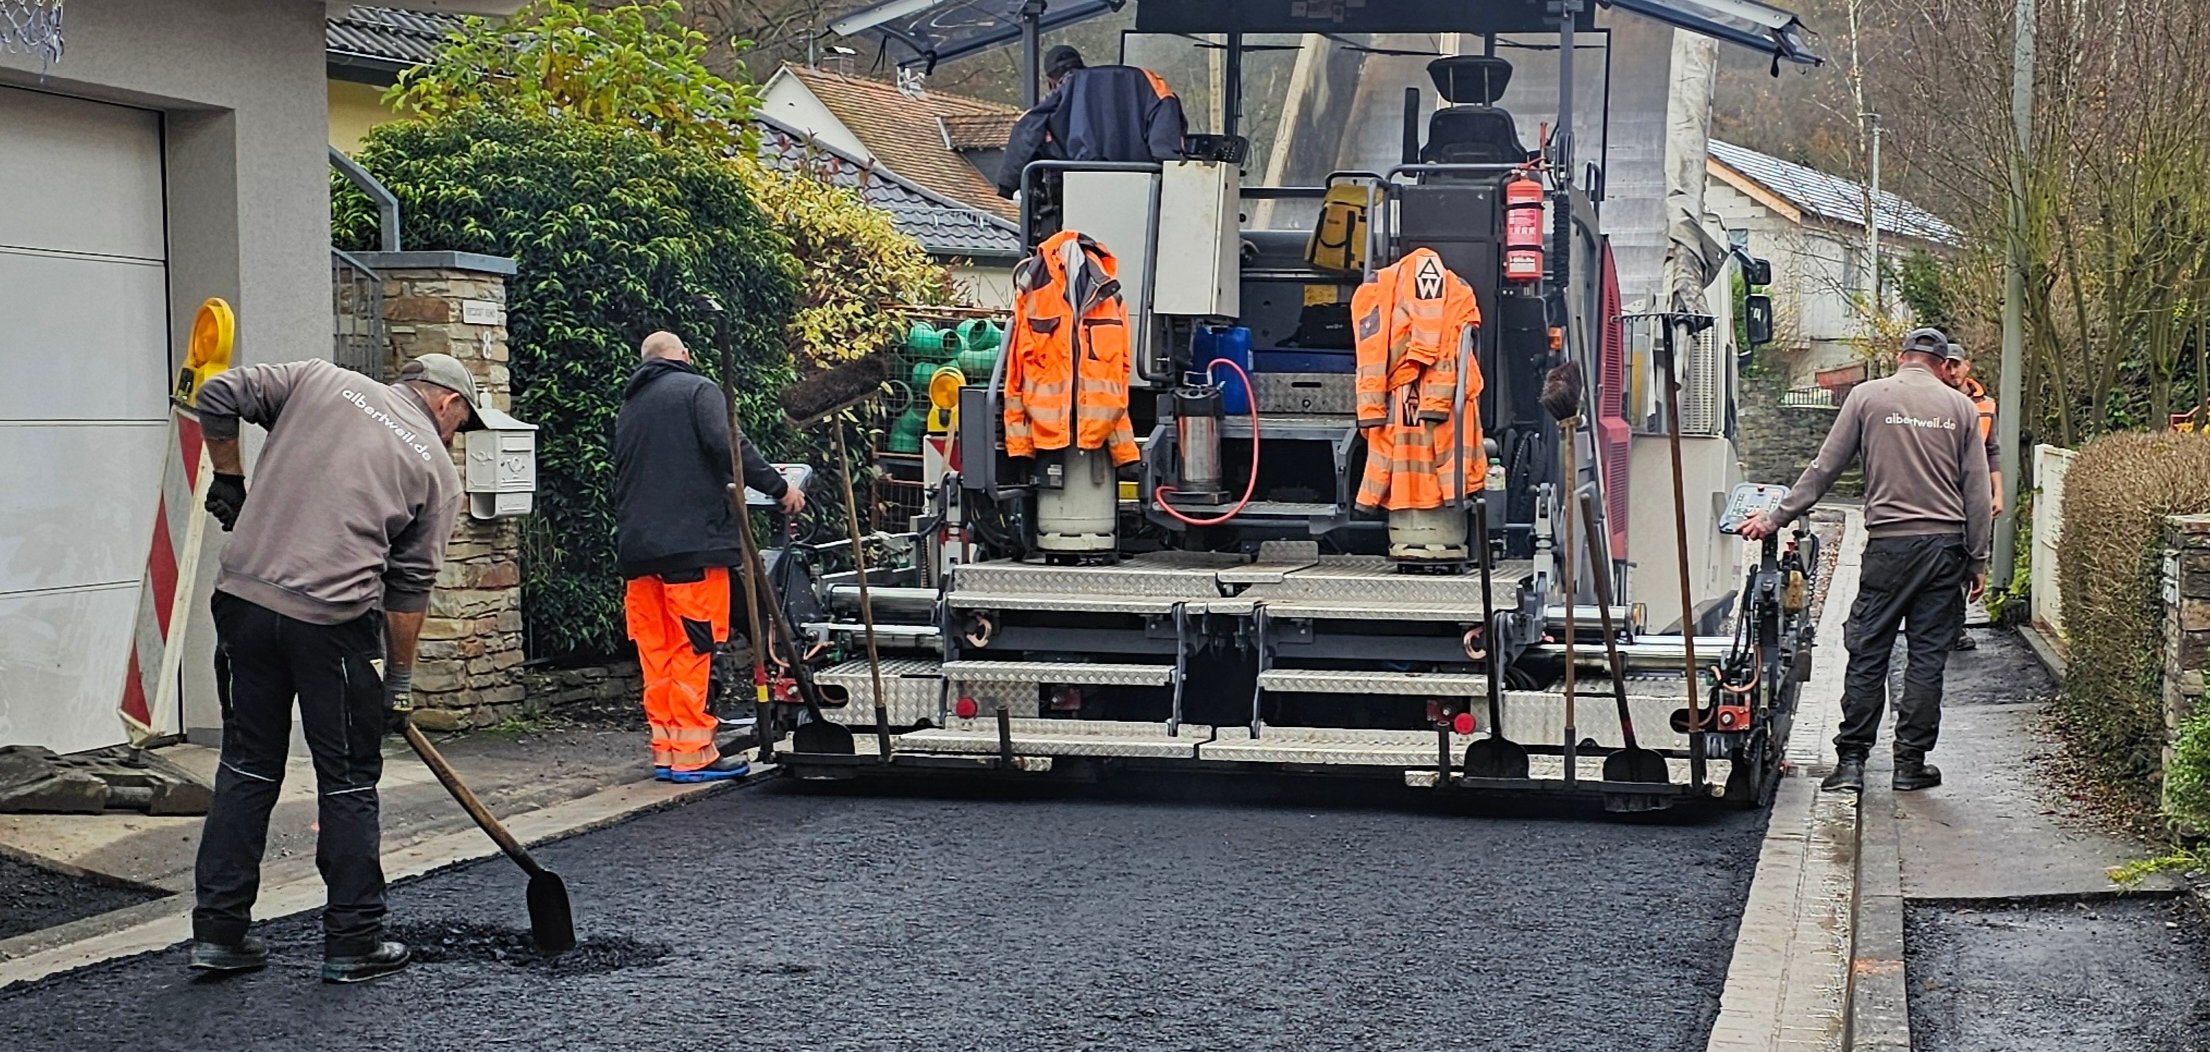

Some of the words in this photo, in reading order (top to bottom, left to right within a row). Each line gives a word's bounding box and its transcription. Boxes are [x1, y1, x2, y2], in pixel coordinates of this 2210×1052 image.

[483, 330, 492, 359] 8
[342, 389, 432, 461] albertweil.de
[1885, 412, 1956, 430] albertweil.de
